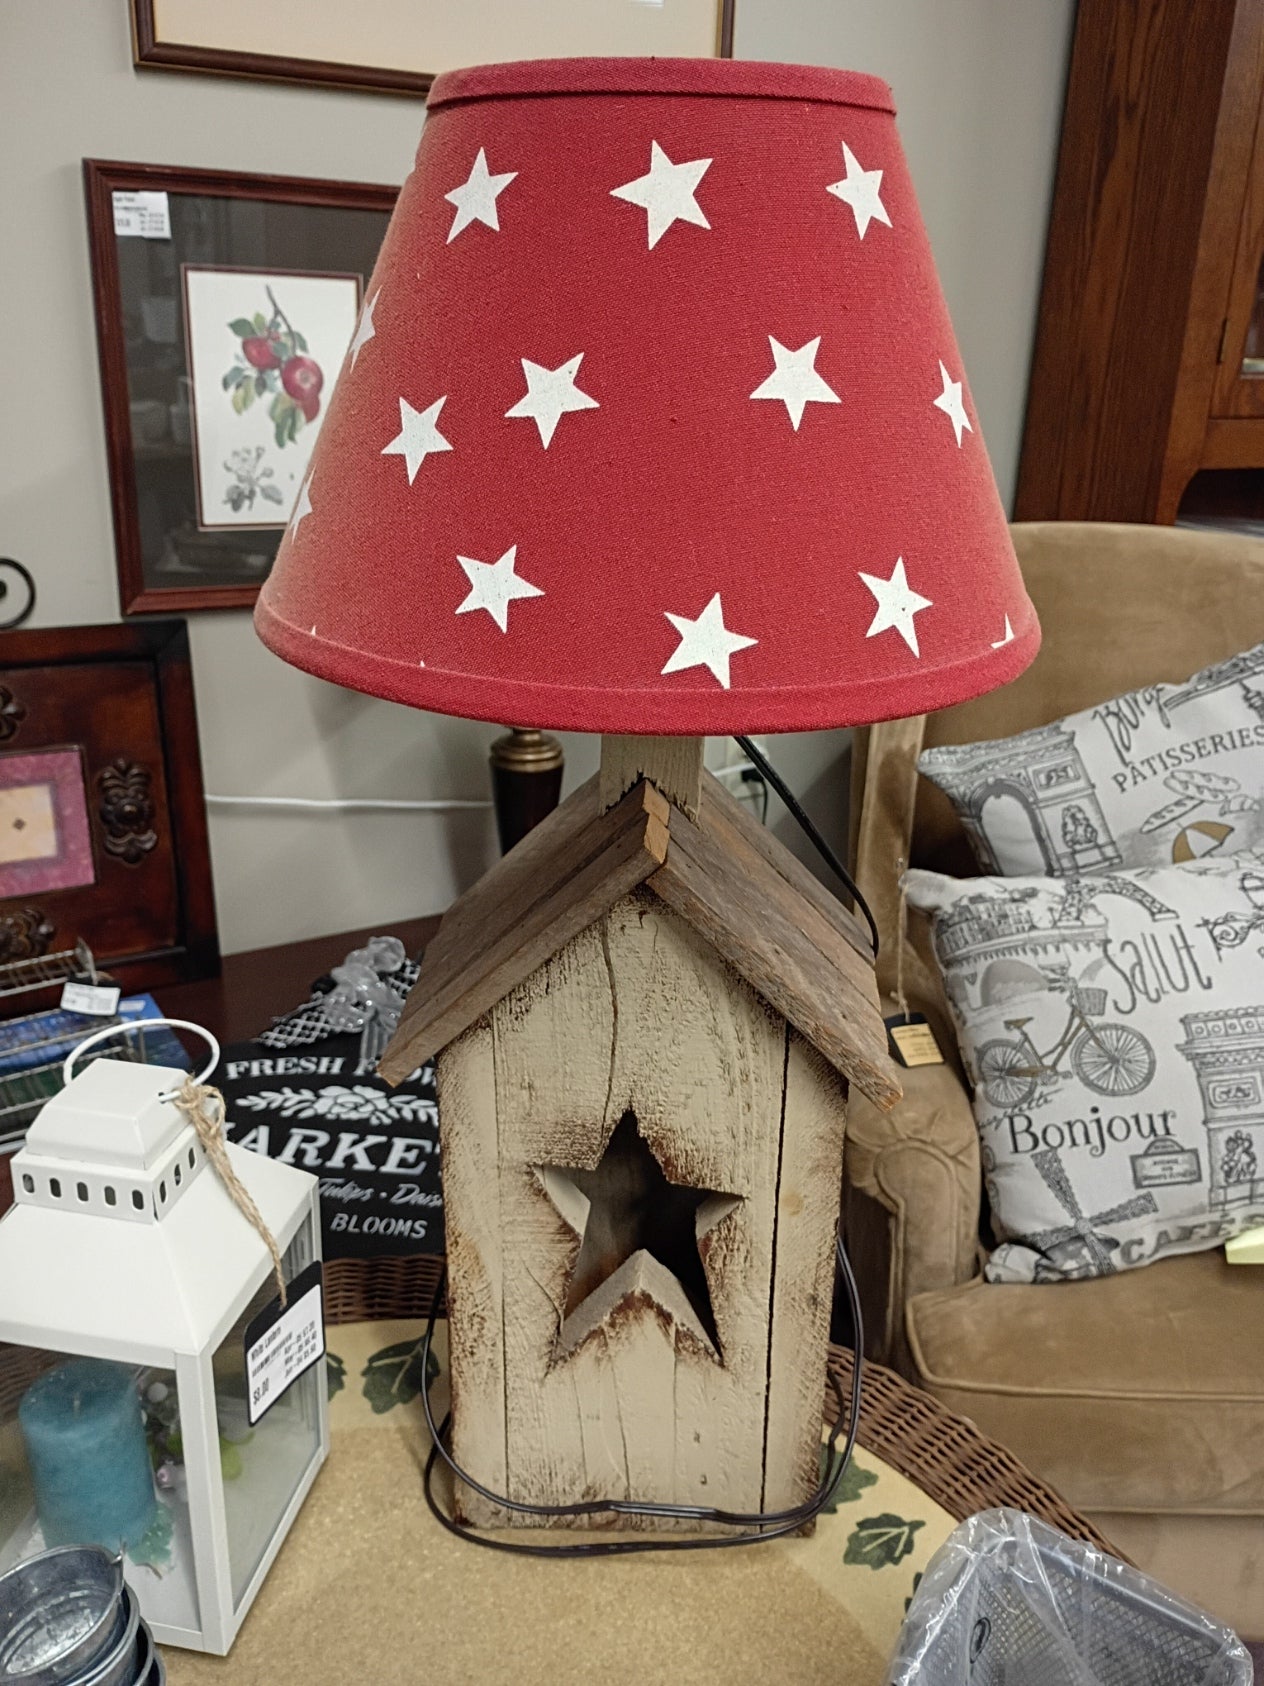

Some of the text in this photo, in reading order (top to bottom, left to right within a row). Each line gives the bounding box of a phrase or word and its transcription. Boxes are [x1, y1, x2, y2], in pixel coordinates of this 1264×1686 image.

[1112, 725, 1264, 793] PÂTISSERIES
[225, 1056, 346, 1080] FRESH
[225, 1121, 442, 1176] ARKE
[1007, 1106, 1177, 1158] Bonjour
[330, 1212, 428, 1239] BLOOMS
